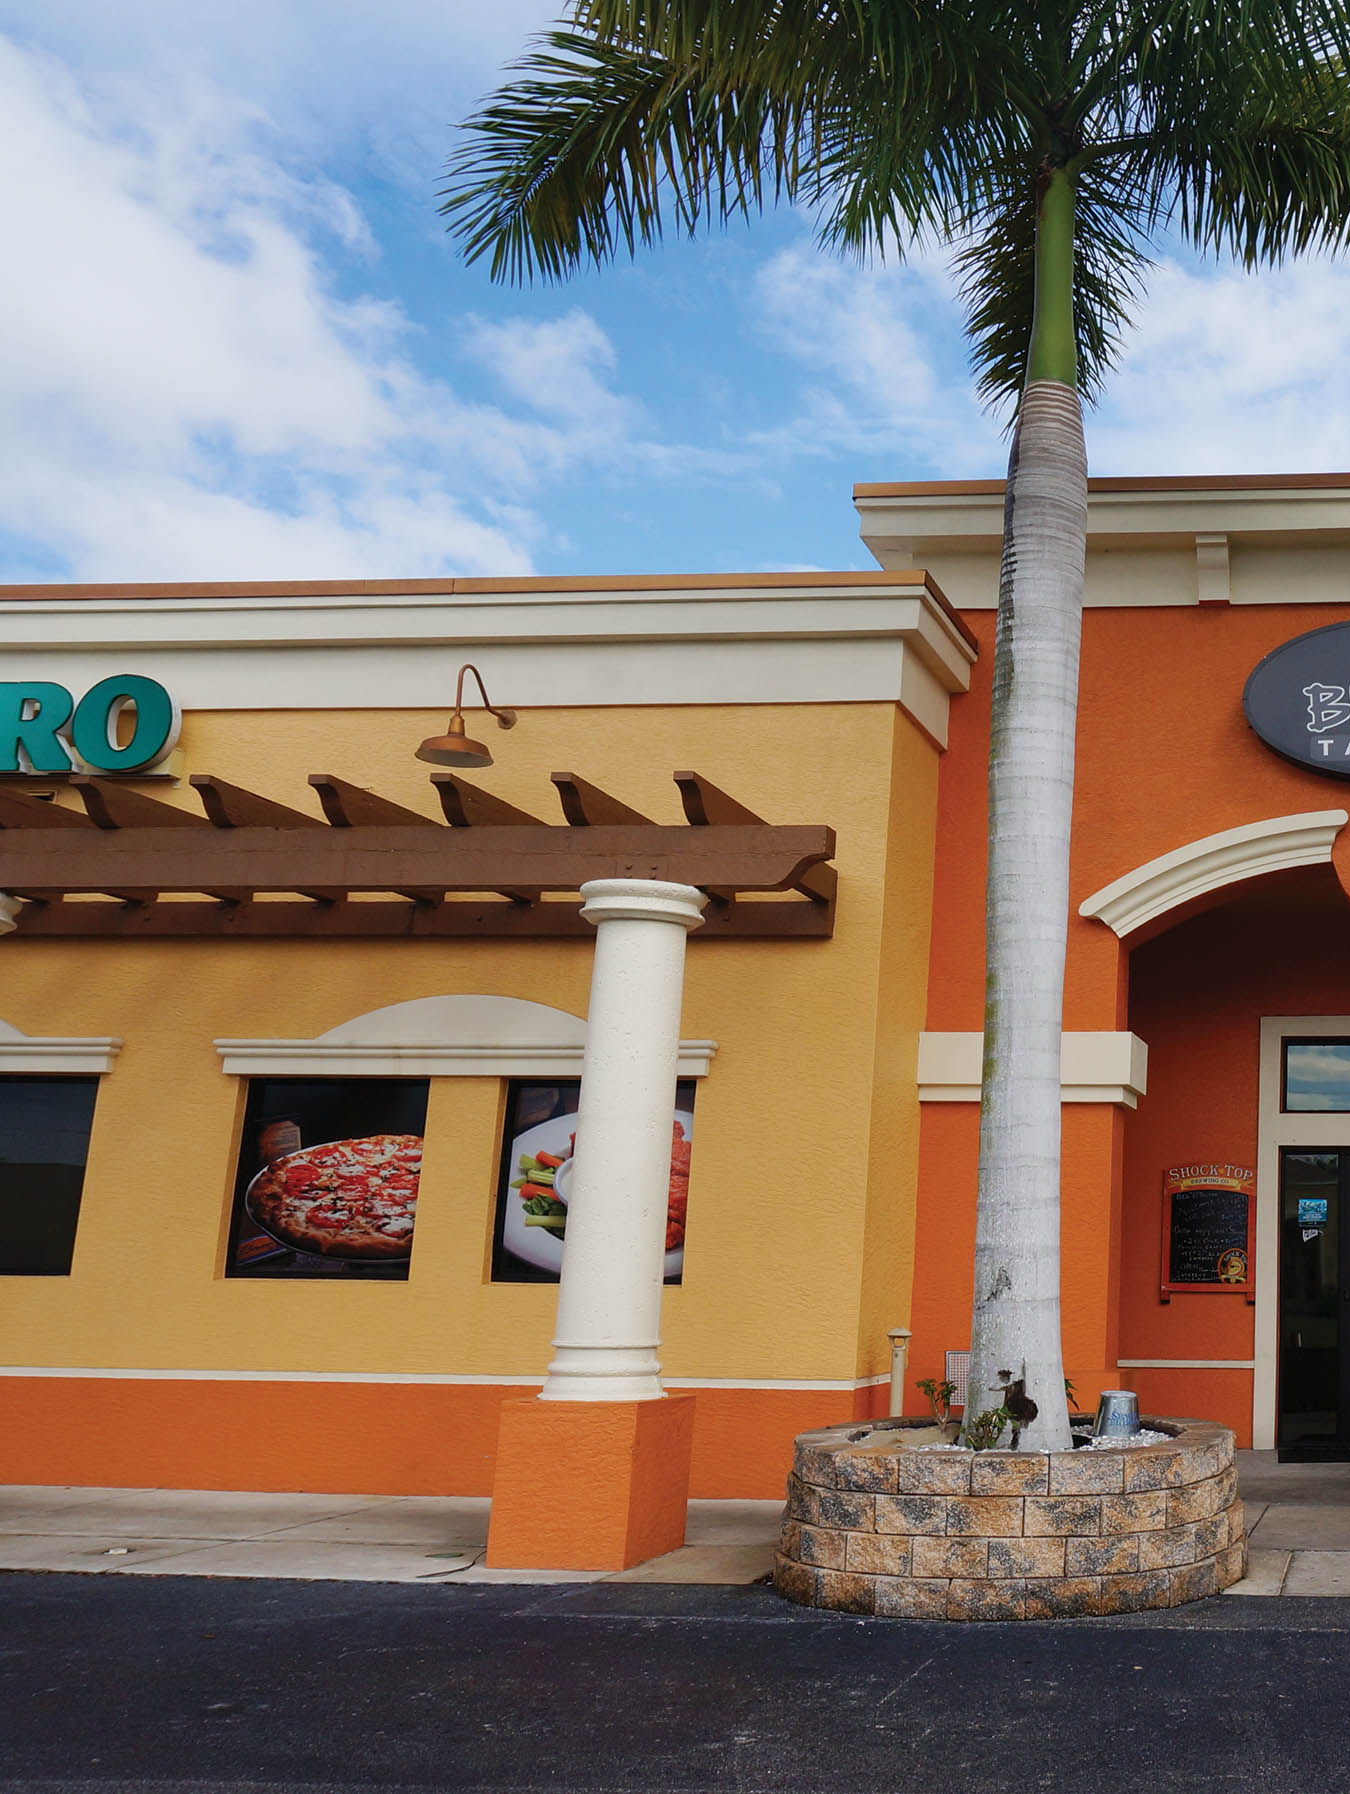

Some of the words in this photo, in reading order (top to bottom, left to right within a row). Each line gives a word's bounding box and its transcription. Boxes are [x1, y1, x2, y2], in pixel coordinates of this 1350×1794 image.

[0, 674, 173, 772] RO
[1169, 1165, 1219, 1180] SHOCK
[1224, 1165, 1253, 1180] TOP
